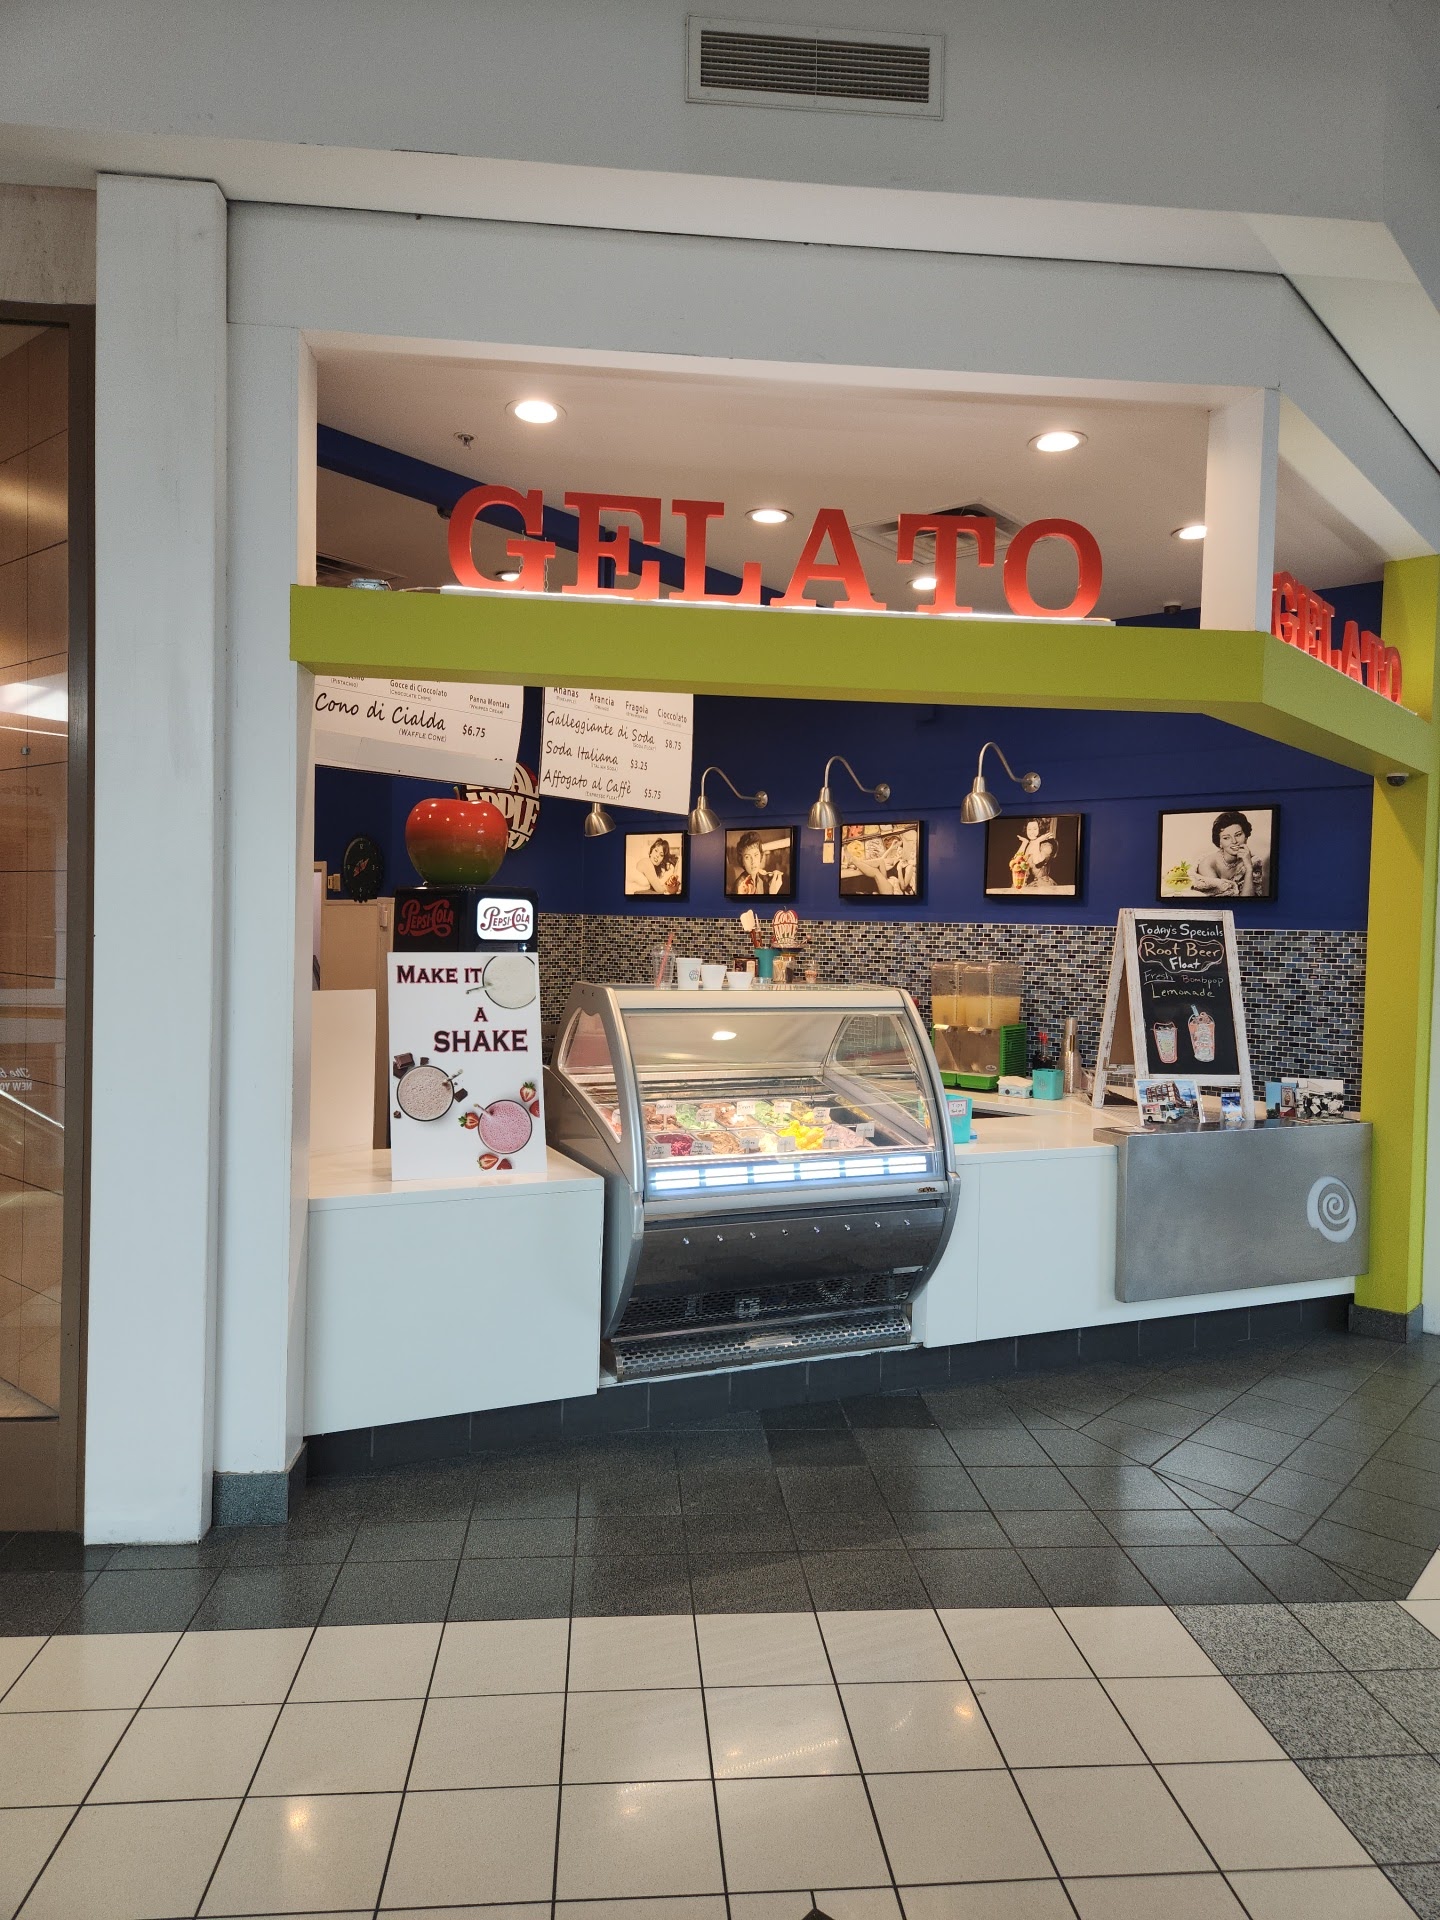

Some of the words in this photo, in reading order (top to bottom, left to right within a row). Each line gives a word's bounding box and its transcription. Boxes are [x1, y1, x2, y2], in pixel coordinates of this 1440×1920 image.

[446, 485, 1103, 618] GELATO
[1272, 571, 1402, 705] GELATO
[390, 680, 408, 690] Gocce
[410, 683, 416, 691] di
[417, 685, 447, 697] Cioccolato
[470, 695, 486, 704] Panna
[488, 698, 510, 709] Montata
[590, 693, 614, 706] Arancia
[315, 692, 359, 715] Cono
[367, 700, 385, 721] di
[392, 706, 446, 730] Cialda
[625, 701, 649, 714] Fragola
[658, 708, 688, 723] Cioccolato
[462, 724, 486, 738] $6.75
[547, 710, 614, 735] Galleggiante
[617, 725, 628, 739] di
[632, 729, 655, 744] Soda
[546, 740, 572, 756] Soda
[578, 746, 618, 765] Italiana
[665, 739, 682, 751] $8.75
[630, 759, 648, 770] $3.25
[543, 769, 588, 790] Affogato
[592, 777, 602, 790] al
[606, 779, 631, 798] Caffè
[644, 788, 662, 800] $5.75
[1138, 923, 1177, 937] Today's
[1179, 923, 1224, 939] Specials
[1143, 942, 1180, 957] Root
[1186, 942, 1220, 957] Beer
[1169, 956, 1201, 970] Float
[1144, 969, 1174, 982] Fresh
[1151, 983, 1215, 998] Lemonade
[473, 1007, 489, 1022] A
[434, 1029, 528, 1053] SHAKE
